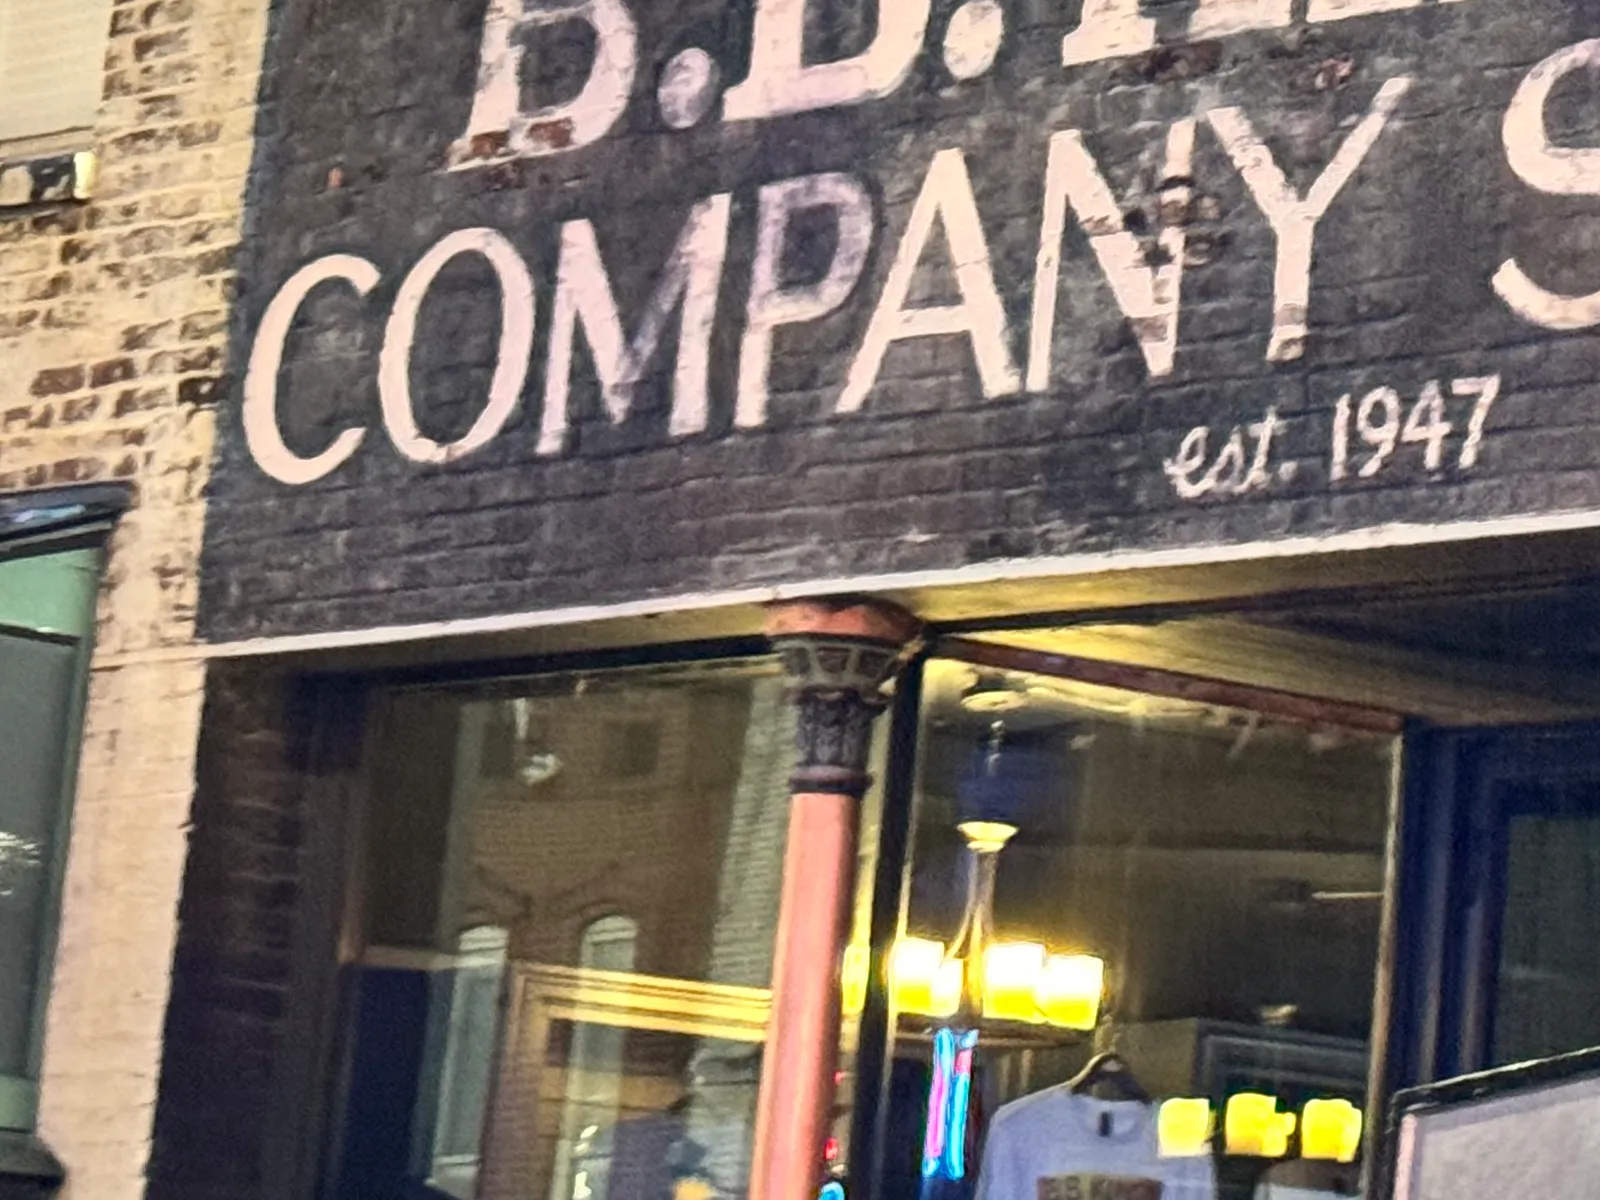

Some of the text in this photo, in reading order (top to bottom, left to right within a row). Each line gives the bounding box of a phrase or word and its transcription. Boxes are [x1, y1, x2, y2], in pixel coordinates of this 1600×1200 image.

[242, 77, 1410, 484] COMPANY
[1163, 373, 1501, 498] est. 1947
